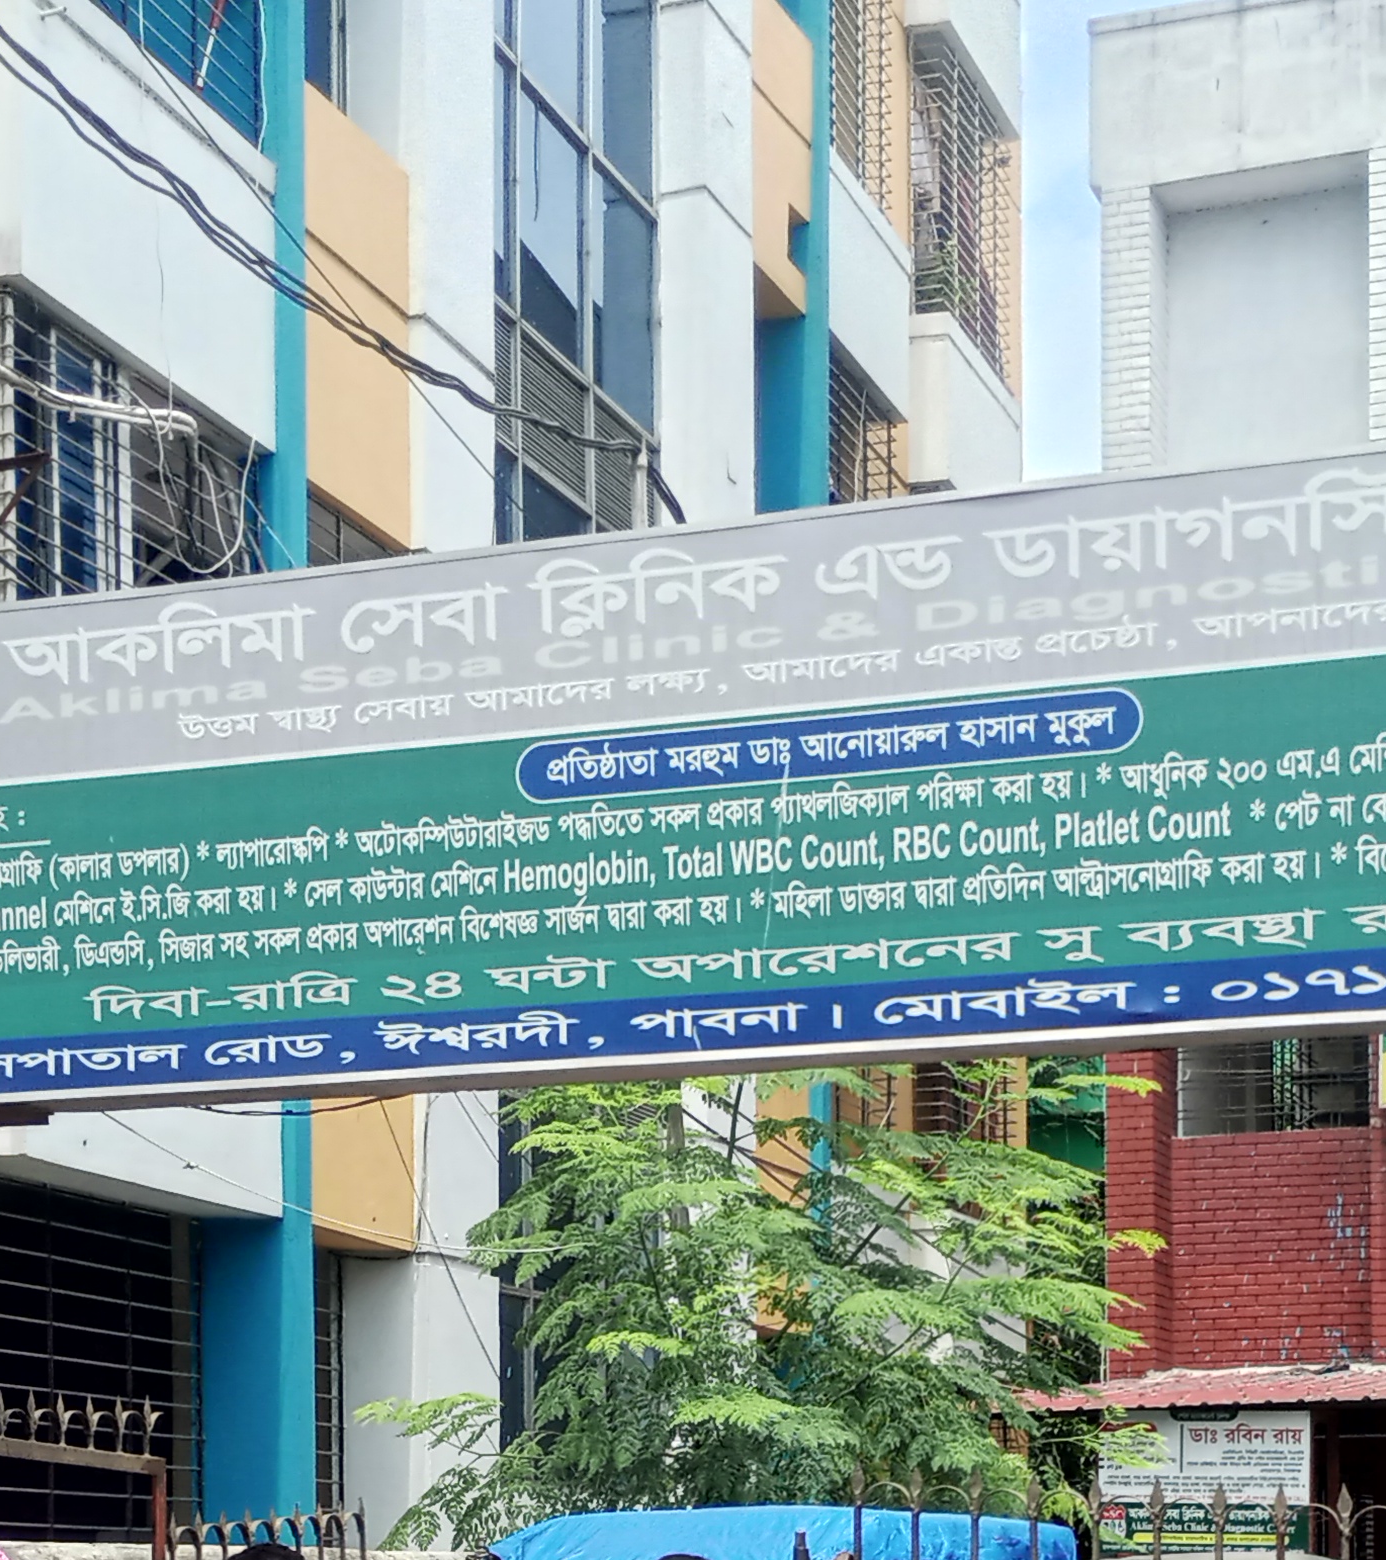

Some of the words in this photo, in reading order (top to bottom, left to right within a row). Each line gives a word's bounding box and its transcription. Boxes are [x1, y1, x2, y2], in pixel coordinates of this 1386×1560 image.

[1, 600, 317, 685] আকলিমা
[340, 581, 510, 653] সেবা
[525, 548, 789, 636] ক্লিনিক
[815, 534, 963, 600] এন্ড
[0, 680, 267, 724] Aklima
[299, 656, 502, 693] Seba
[535, 625, 782, 668] Clinic
[817, 612, 877, 640] &
[176, 712, 260, 739] উত্তম
[353, 693, 455, 724] সেবায়
[463, 677, 615, 712] আমাদের
[740, 648, 902, 684] আমাদের
[914, 635, 1023, 667] একান্ত
[664, 741, 742, 776] মরহুম
[747, 736, 791, 765] ডাঃ
[798, 722, 951, 761] আনোয়ারুল
[955, 714, 1039, 748] হাসান
[1043, 706, 1117, 745] মুকুল
[49, 852, 113, 892] (কালার
[116, 843, 190, 887] ডপলার)
[647, 803, 702, 833] সকল
[706, 797, 765, 830] প্রকার
[989, 771, 1035, 805] করা
[52, 890, 116, 940] মেশিনে
[193, 885, 232, 916] করা
[304, 878, 343, 908] সেল
[346, 865, 426, 904] কাউন্টার
[431, 860, 499, 908] মেশিনে
[503, 849, 656, 899] Hemoglobin,
[662, 842, 723, 880] Total
[729, 837, 796, 883] WBC
[797, 830, 885, 882] Count,
[893, 823, 951, 863] RBC
[959, 817, 1046, 867] Count,
[1055, 809, 1140, 860] Platlet
[1147, 801, 1231, 852] Count
[380, 971, 462, 1004] ২৪
[630, 930, 1021, 983] অপারেশনের
[1036, 926, 1105, 963] সু
[1118, 908, 1326, 952] ব্যবস্থা
[873, 978, 1136, 1025] মোবাইল
[1187, 1427, 1218, 1445] ডাঃ
[1224, 1423, 1267, 1445] রবিন
[1272, 1427, 1305, 1445] রায়
